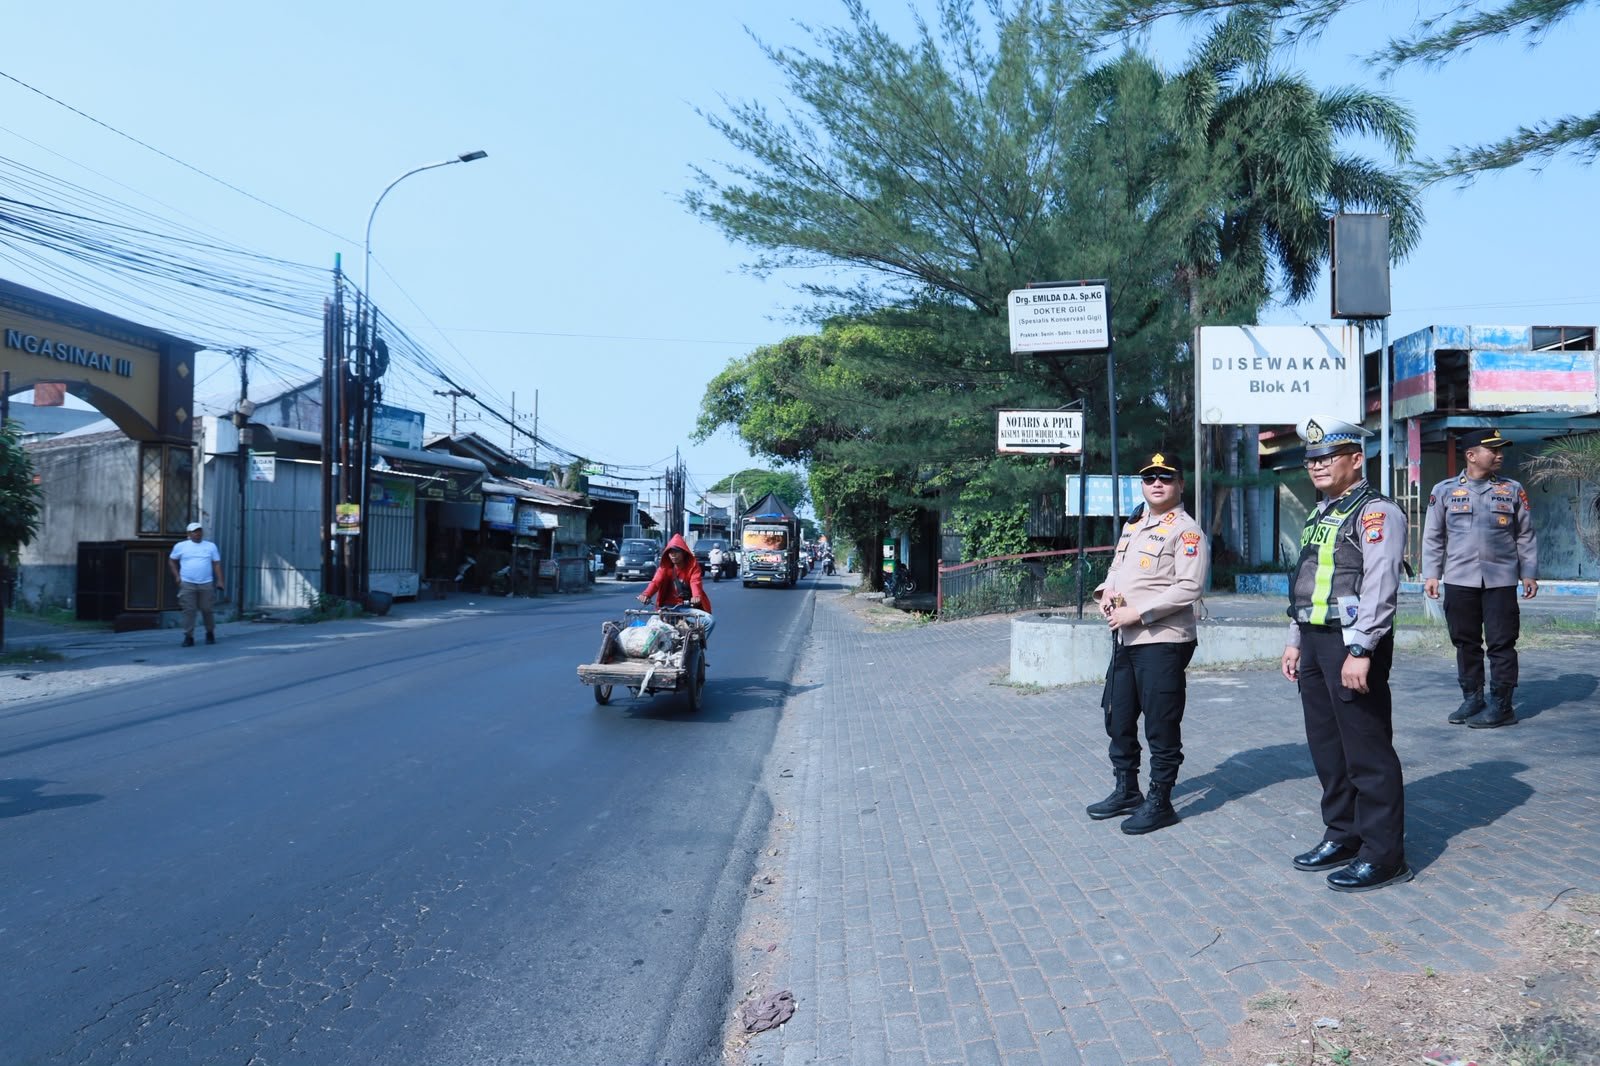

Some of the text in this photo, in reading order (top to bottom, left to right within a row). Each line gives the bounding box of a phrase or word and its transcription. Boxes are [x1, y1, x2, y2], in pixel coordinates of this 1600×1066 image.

[1016, 296, 1030, 305] Drg.
[1033, 294, 1061, 302] EMILDA
[1080, 292, 1101, 302] Sp.KG
[1034, 305, 1086, 315] DOKTER GIGI
[5, 328, 133, 377] NGASINAN III
[1212, 357, 1347, 371] DISEWAKAN
[1249, 380, 1310, 393] Blok A1
[1006, 416, 1073, 428] NOTARIS & PPAT
[1148, 534, 1167, 543] POLRI
